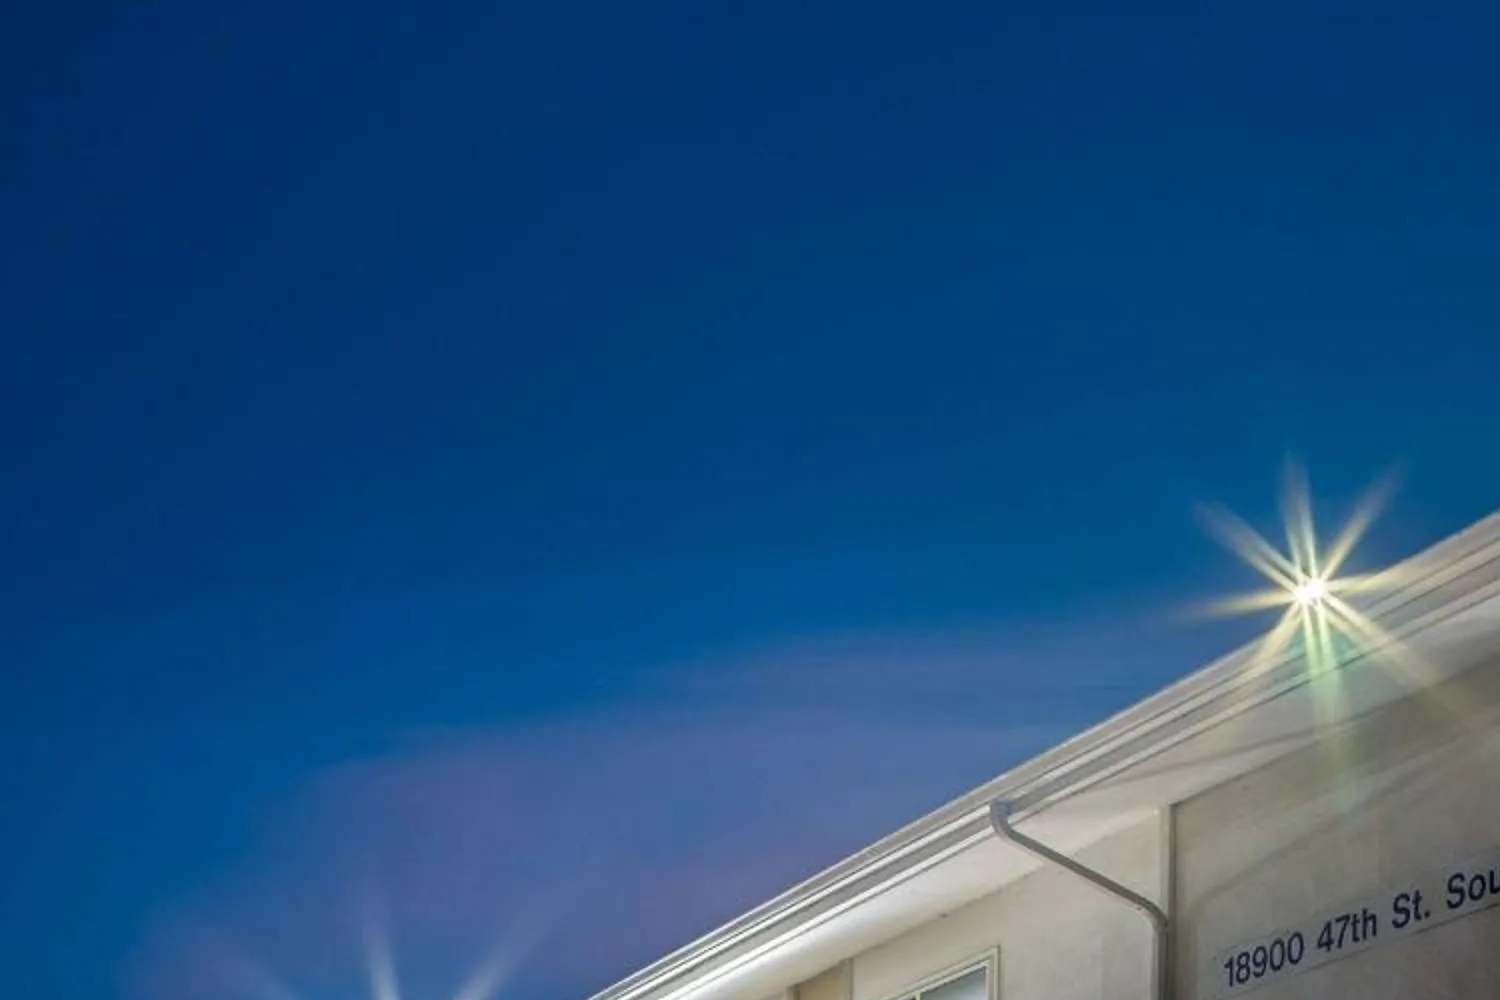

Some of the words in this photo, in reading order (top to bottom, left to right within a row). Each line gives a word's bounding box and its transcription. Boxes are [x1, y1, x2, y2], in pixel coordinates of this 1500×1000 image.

[1224, 933, 1304, 987] 18900
[1317, 908, 1378, 953] 47th
[1391, 891, 1432, 930] St.
